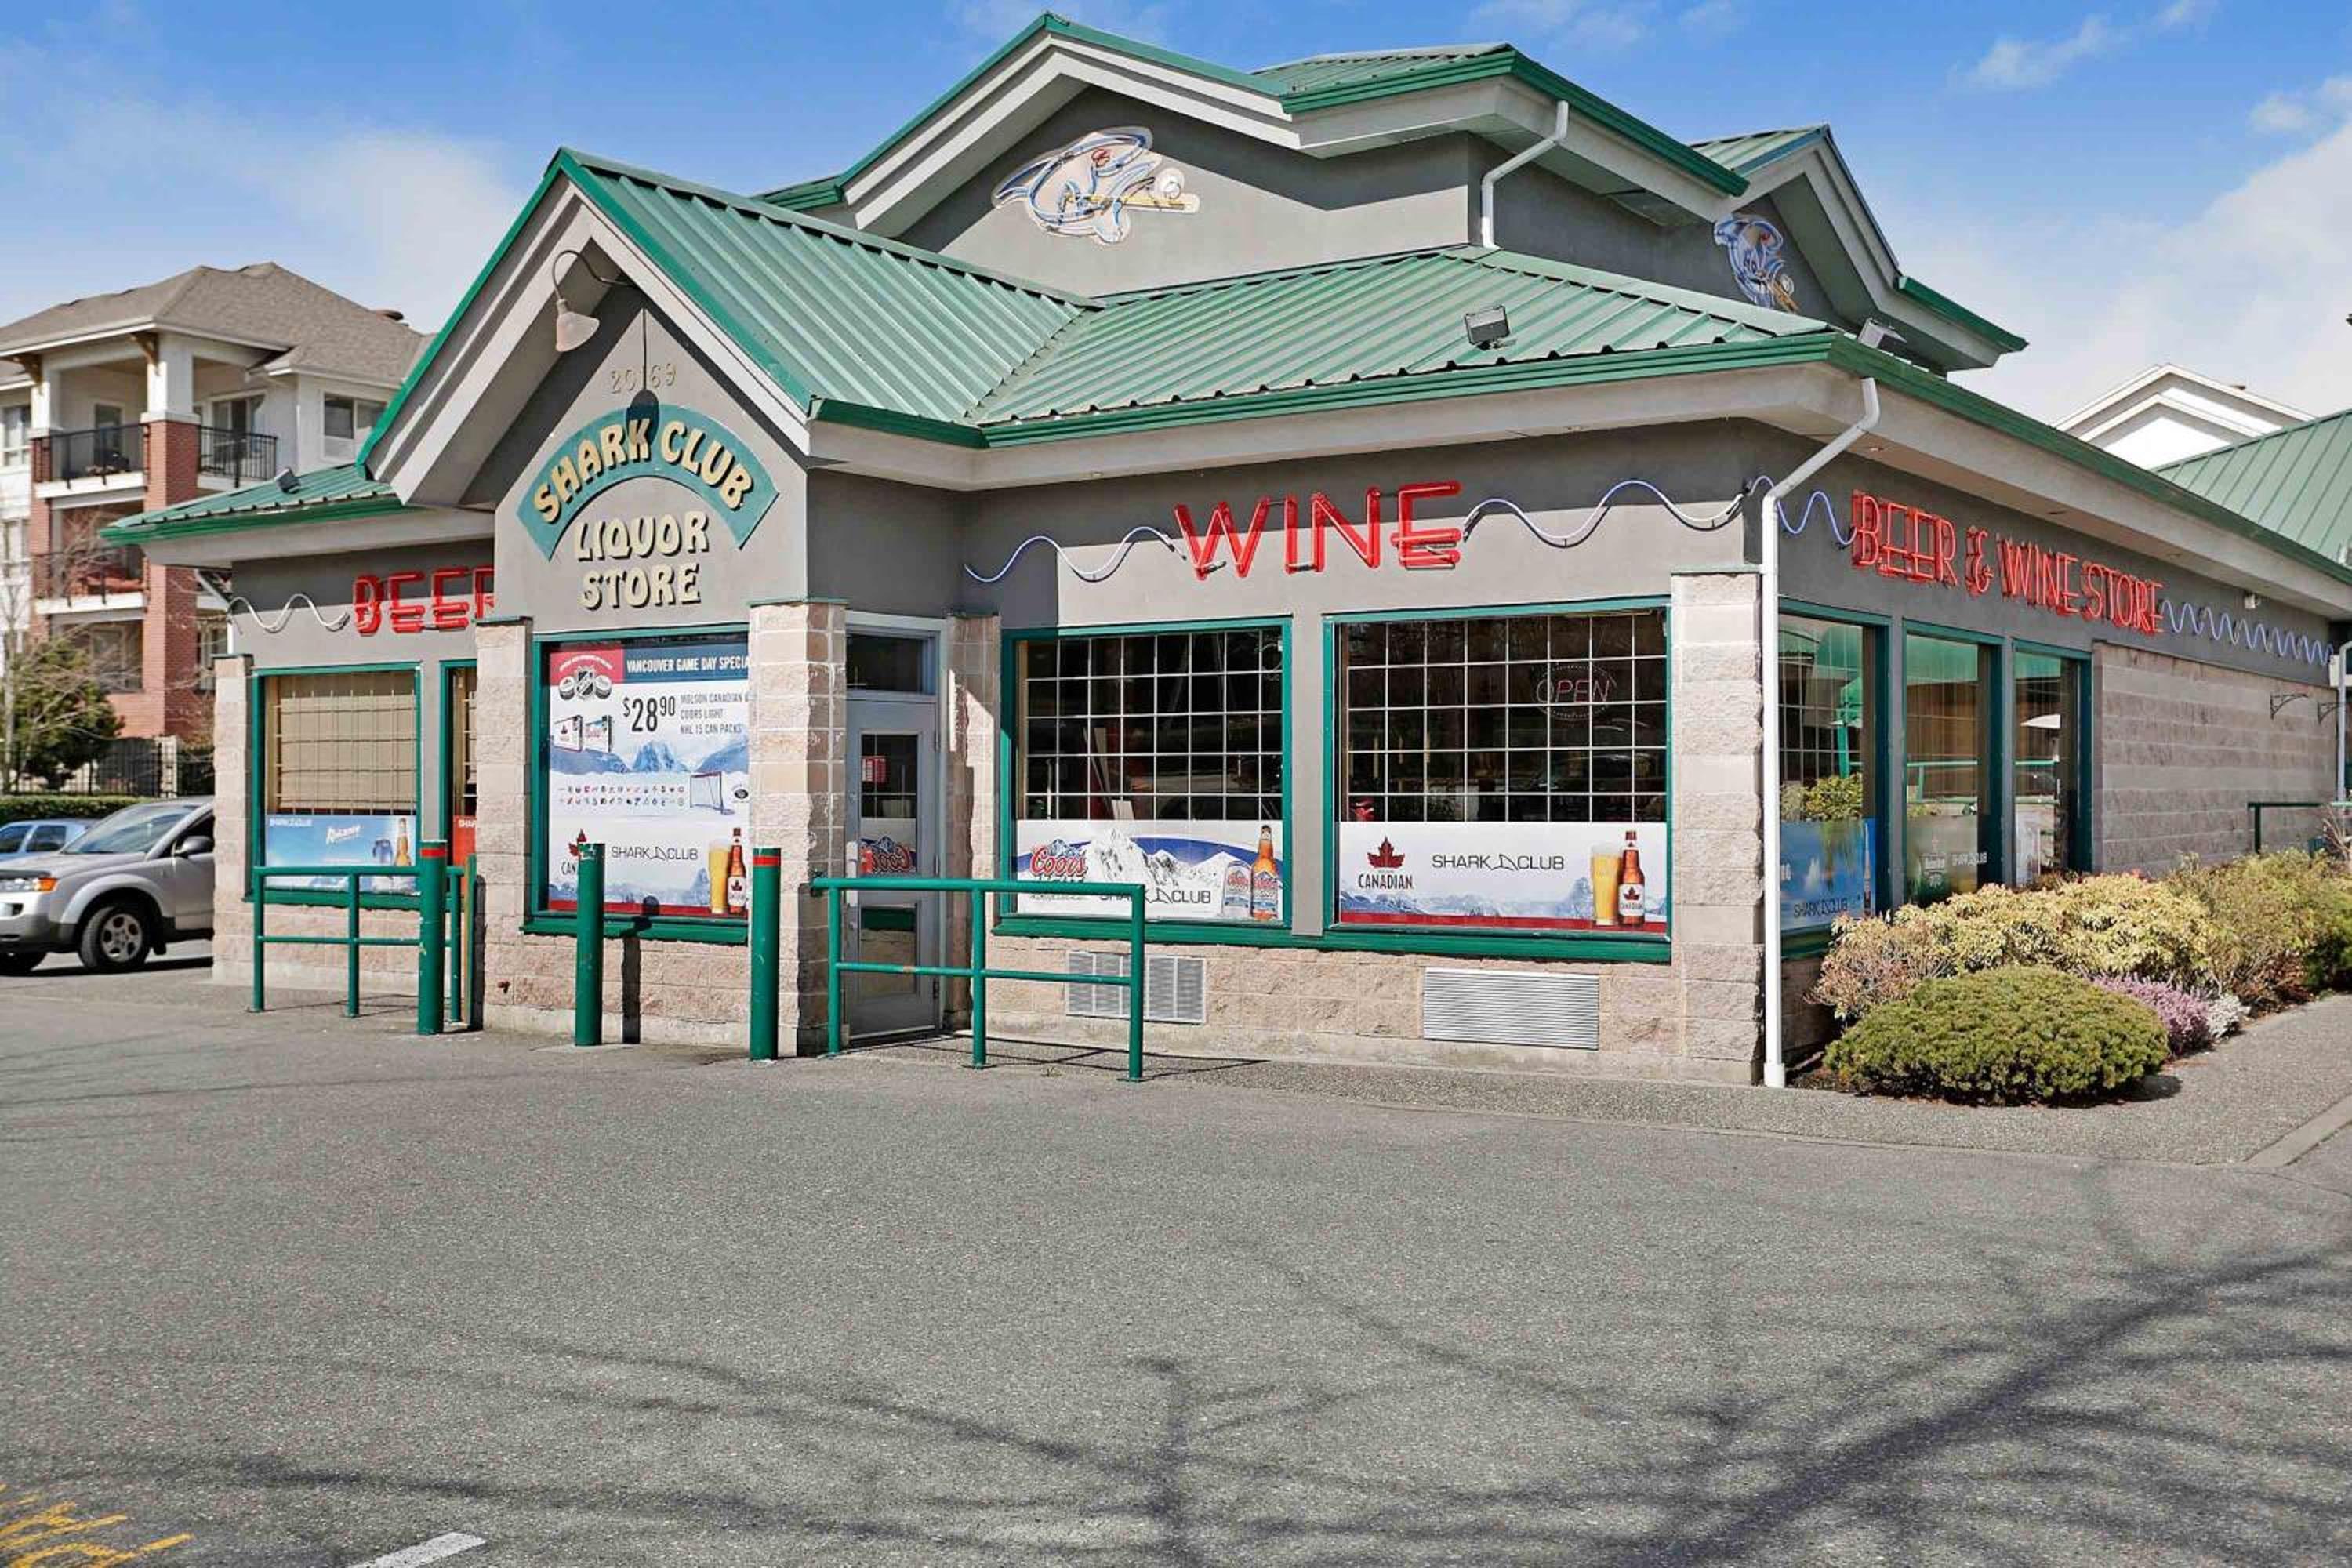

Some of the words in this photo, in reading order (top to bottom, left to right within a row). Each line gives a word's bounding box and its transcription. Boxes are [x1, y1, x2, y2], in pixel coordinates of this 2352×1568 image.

[534, 418, 652, 523] SHARK
[661, 421, 754, 510] CLUB
[575, 510, 710, 562] LIQUOR
[1175, 481, 1463, 580] WINE
[1853, 489, 1958, 588] BEER
[1966, 526, 1994, 597] &
[1996, 533, 2080, 618] WINE
[2081, 559, 2164, 637] STORE
[577, 562, 702, 610] STORE
[627, 659, 674, 673] VANCOUVER
[676, 658, 699, 671] GAME
[701, 657, 717, 670] DAY
[709, 692, 742, 703] CANADIAN
[1536, 679, 1610, 704] OPEN
[680, 709, 702, 720] COORS
[705, 723, 718, 735] CAN
[720, 722, 742, 734] PACKS
[612, 846, 650, 859] SHARK
[667, 848, 699, 861] CLUB
[1029, 845, 1087, 877] Coors
[1432, 854, 1490, 869] SHARK
[1517, 855, 1565, 871] CLUB
[1358, 873, 1414, 890] CANADIAN
[1171, 890, 1211, 904] CLUB
